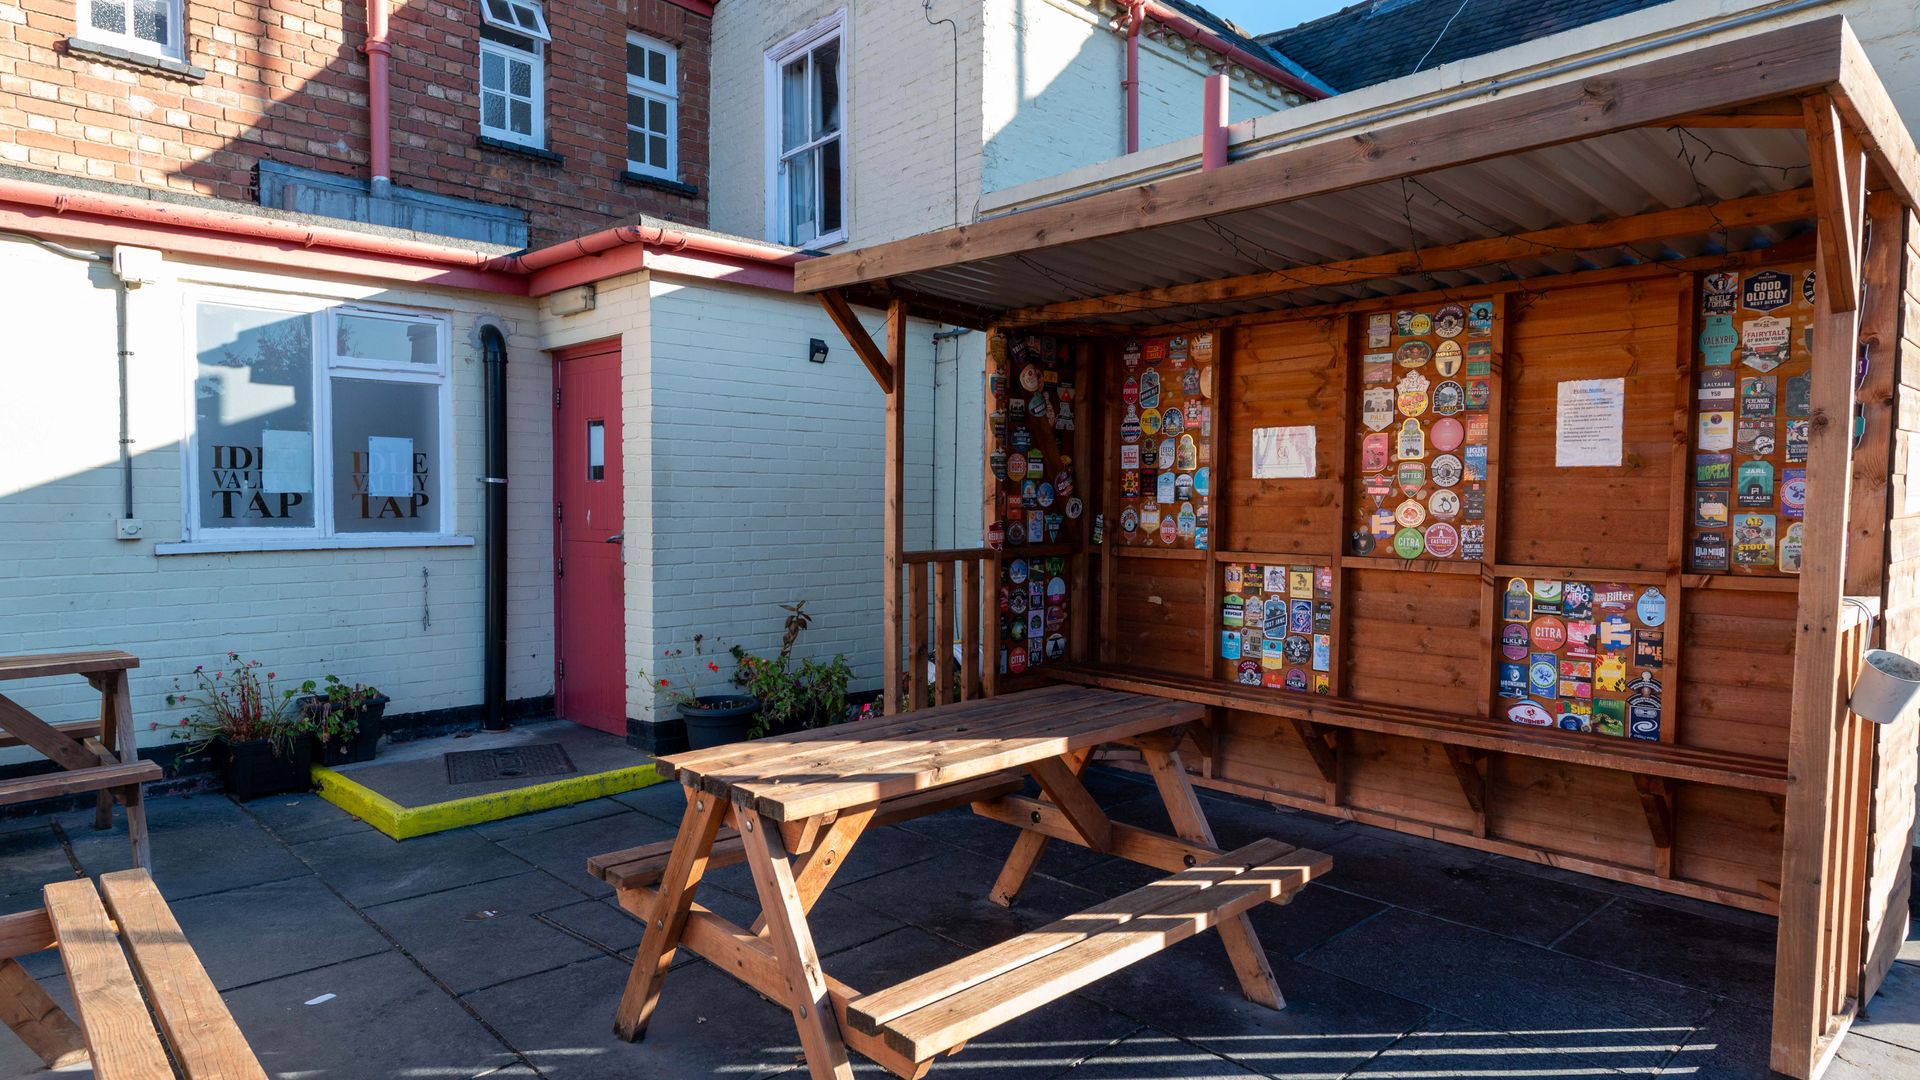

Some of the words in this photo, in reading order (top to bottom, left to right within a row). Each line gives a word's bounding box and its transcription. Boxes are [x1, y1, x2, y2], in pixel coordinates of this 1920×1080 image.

[1753, 281, 1781, 292] GOOD
[1746, 293, 1765, 302] OLD
[1766, 289, 1788, 300] BOY
[1746, 330, 1786, 338] FAIRYTALE
[1703, 335, 1735, 345] VALKYRIE
[1698, 463, 1730, 475] HOPPY
[211, 490, 304, 518] TAP
[351, 493, 430, 518] TAP
[1398, 538, 1420, 548] CITRA
[1738, 543, 1769, 552] STOUT
[1565, 583, 1587, 593] BEAT
[1607, 591, 1634, 602] Bitter
[1535, 626, 1562, 639] CITRA
[1503, 637, 1528, 645] ILKLEY
[1010, 654, 1025, 664] CITRA
[1286, 679, 1305, 688] ILKLEY
[1514, 715, 1546, 725] FINISHER
